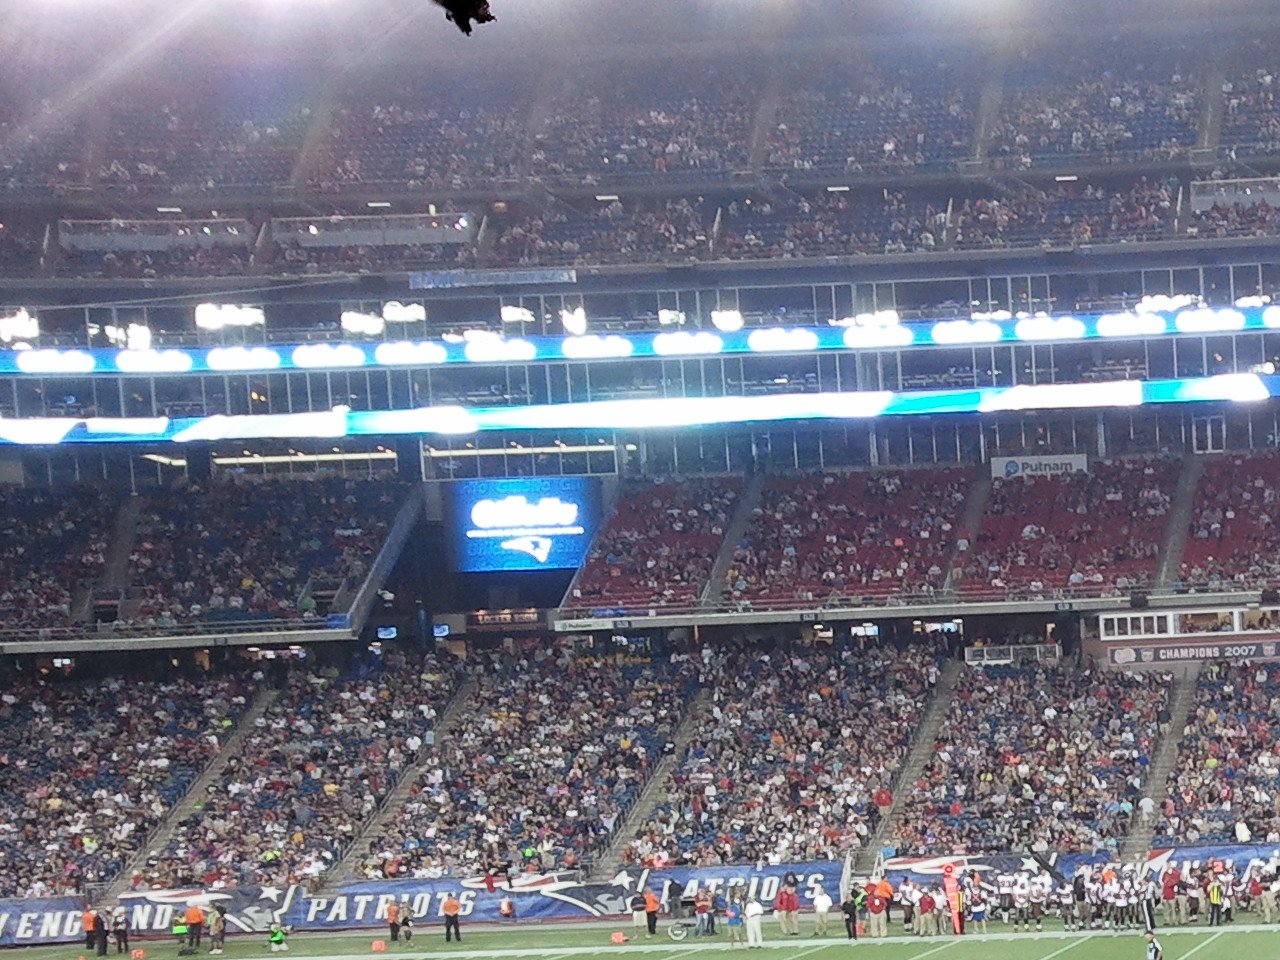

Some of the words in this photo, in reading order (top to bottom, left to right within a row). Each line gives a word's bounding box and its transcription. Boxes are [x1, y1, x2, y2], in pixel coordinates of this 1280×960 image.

[1021, 460, 1073, 472] Putnam
[1159, 646, 1220, 660] CHAMPIONS
[1223, 645, 1257, 658] 2007
